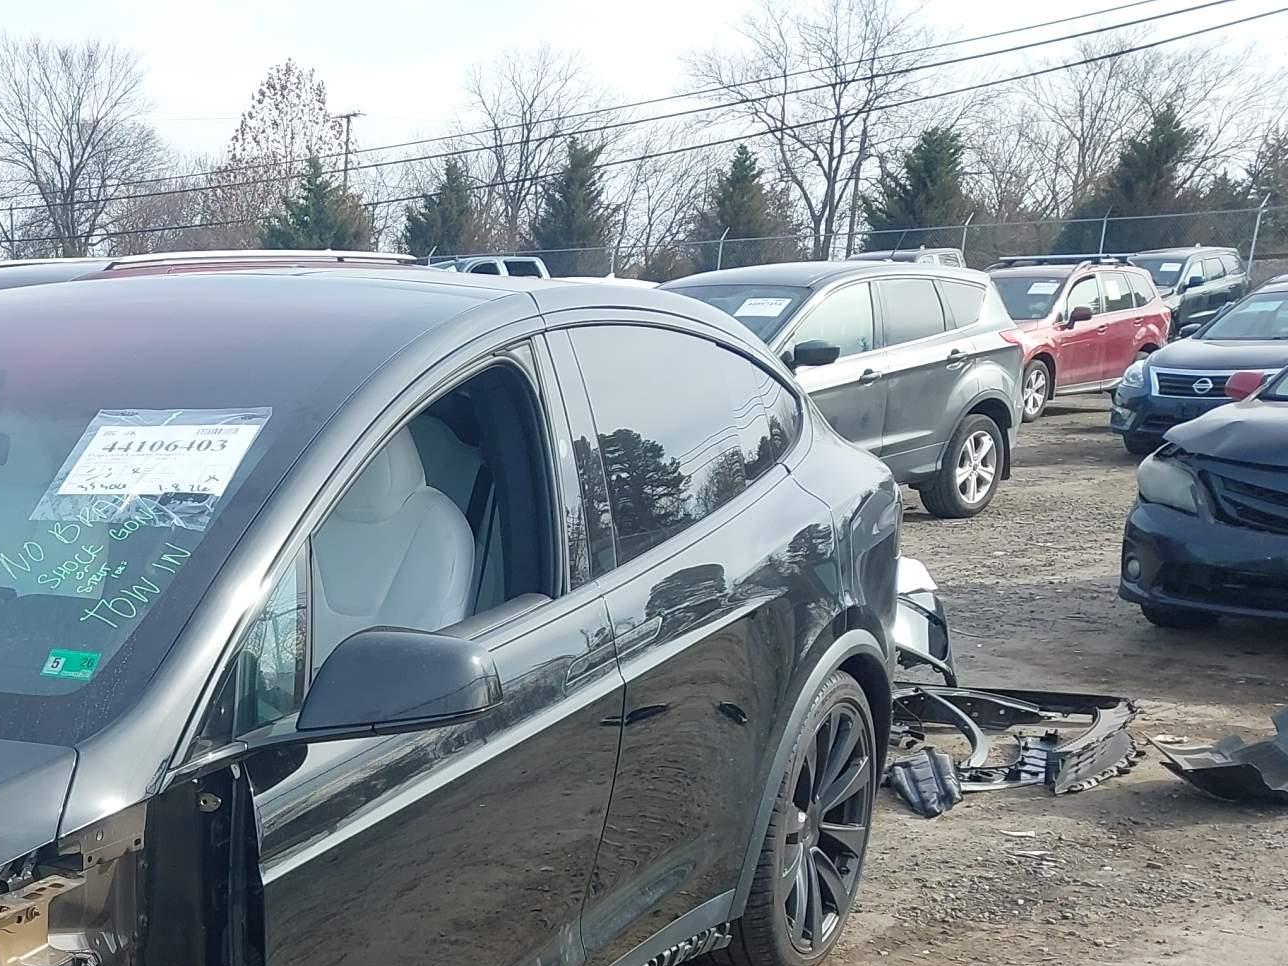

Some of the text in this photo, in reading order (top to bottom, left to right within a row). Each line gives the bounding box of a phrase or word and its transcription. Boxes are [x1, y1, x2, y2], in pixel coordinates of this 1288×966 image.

[102, 439, 228, 453] 44106403
[0, 541, 44, 579] NO
[38, 544, 104, 589] SHOCK
[80, 577, 160, 628] TOW
[152, 542, 191, 574] IN
[50, 657, 94, 669] 5 26
